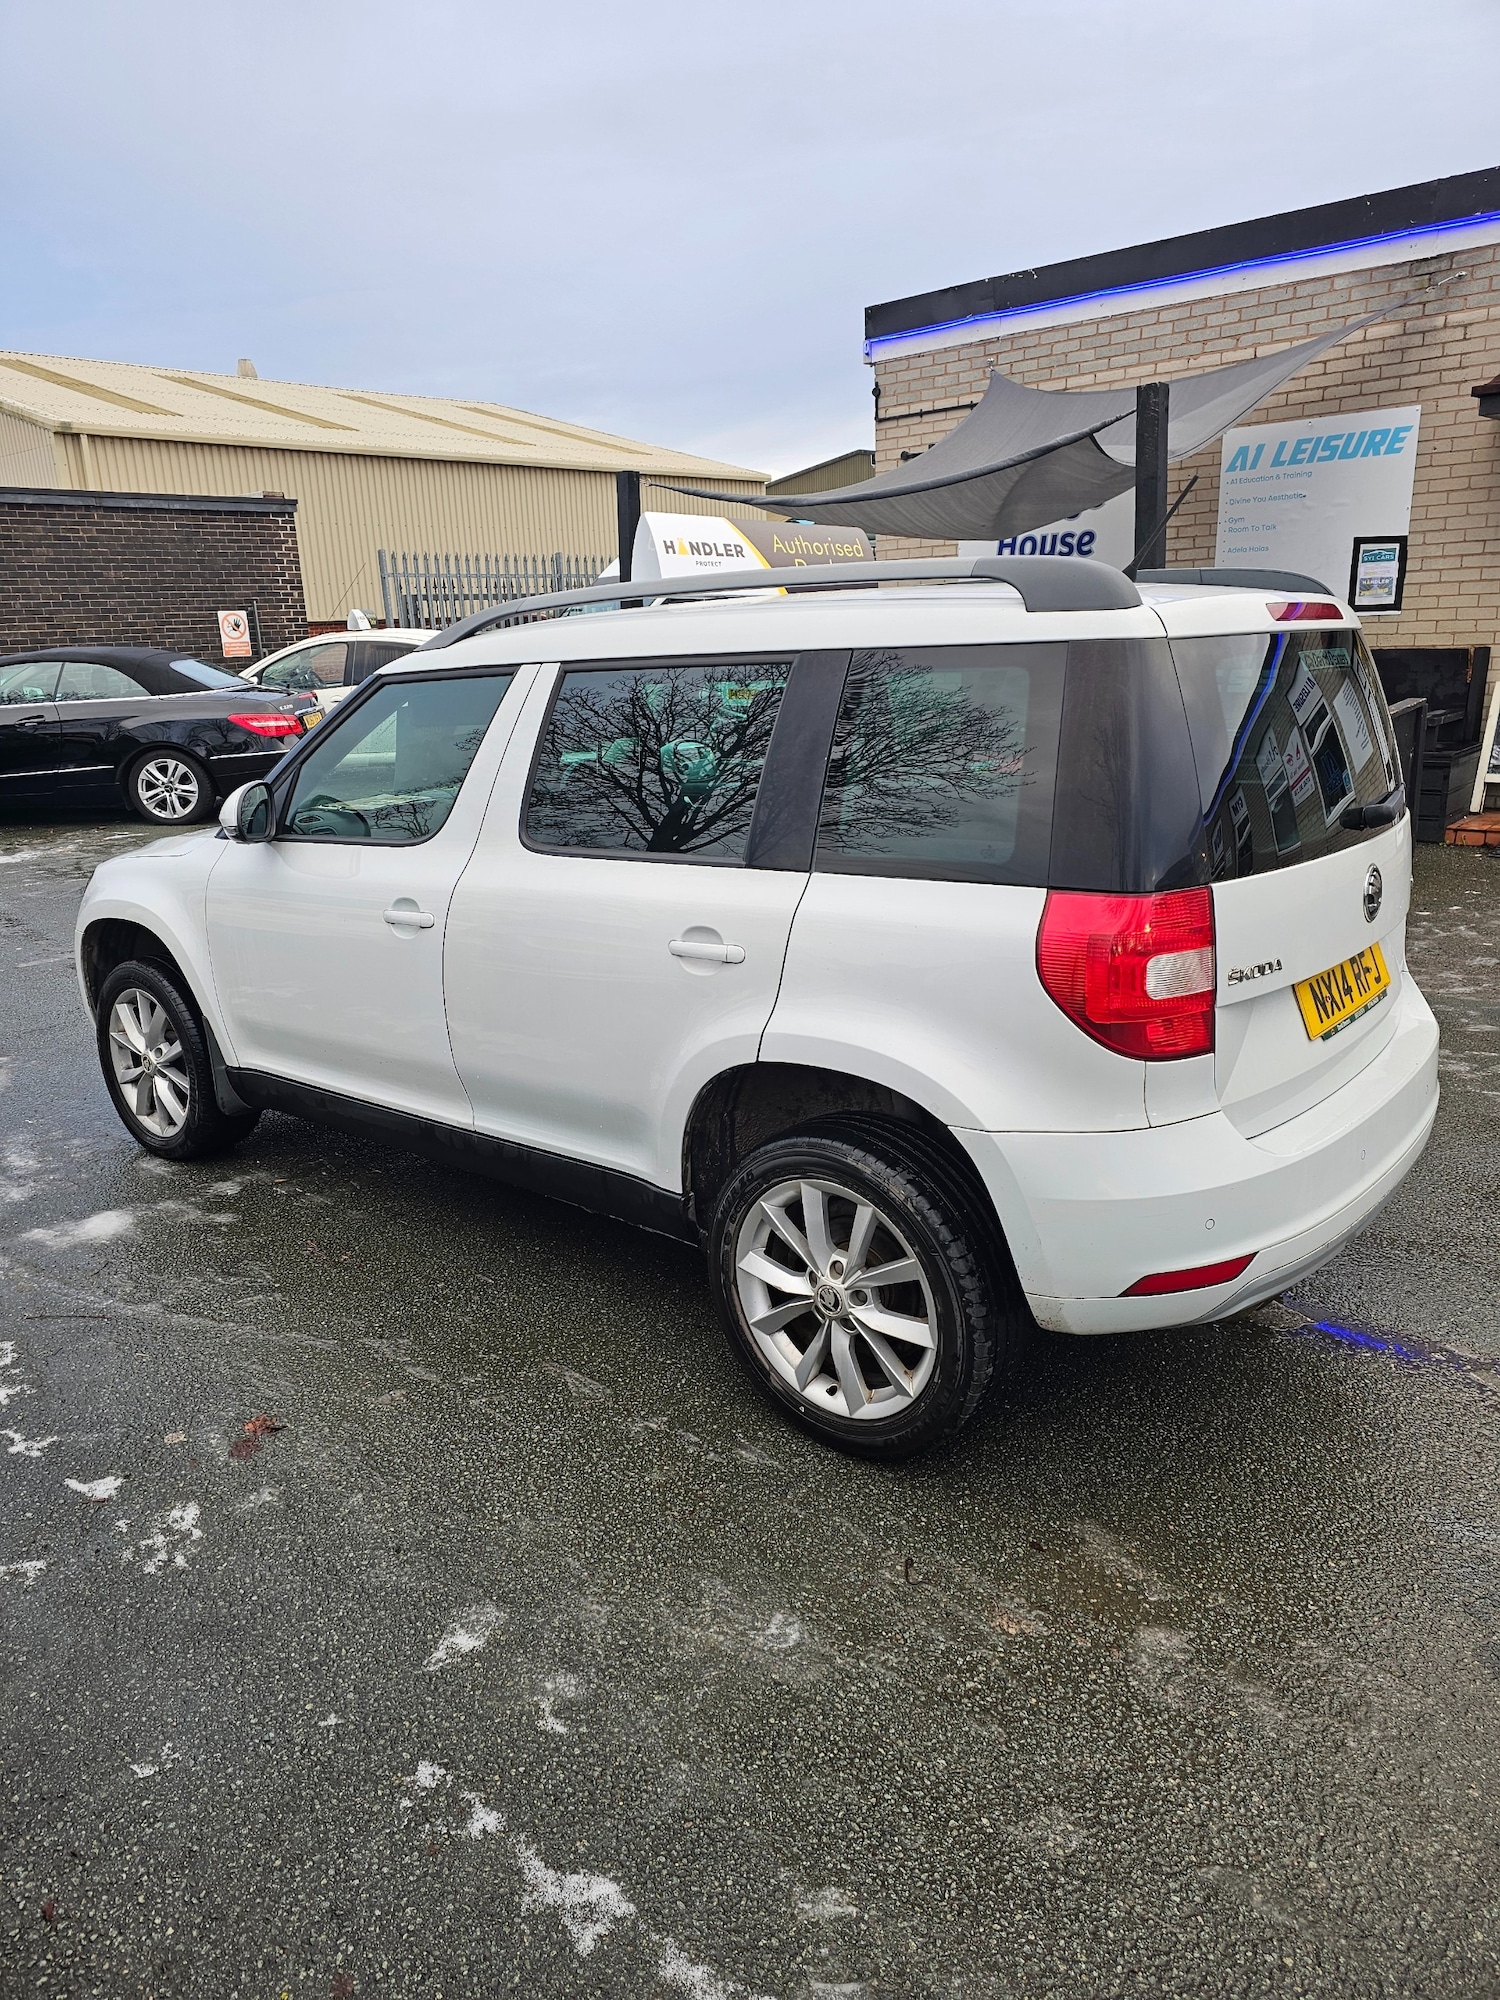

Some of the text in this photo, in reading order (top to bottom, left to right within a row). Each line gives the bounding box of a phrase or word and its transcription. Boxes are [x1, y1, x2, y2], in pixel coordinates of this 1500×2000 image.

[1270, 425, 1414, 468] LEISURE
[1239, 473, 1274, 485] Education
[1282, 470, 1313, 480] Training
[1229, 491, 1307, 506] Divine You Aesthetic
[1228, 516, 1245, 525] Gym
[1228, 526, 1249, 534] Room
[773, 534, 865, 557] Authorised
[996, 530, 1097, 557] House
[1227, 546, 1248, 554] Adela
[695, 560, 722, 568] PROTECT
[1308, 964, 1355, 1025] NX14
[1348, 946, 1382, 998] RFJ
